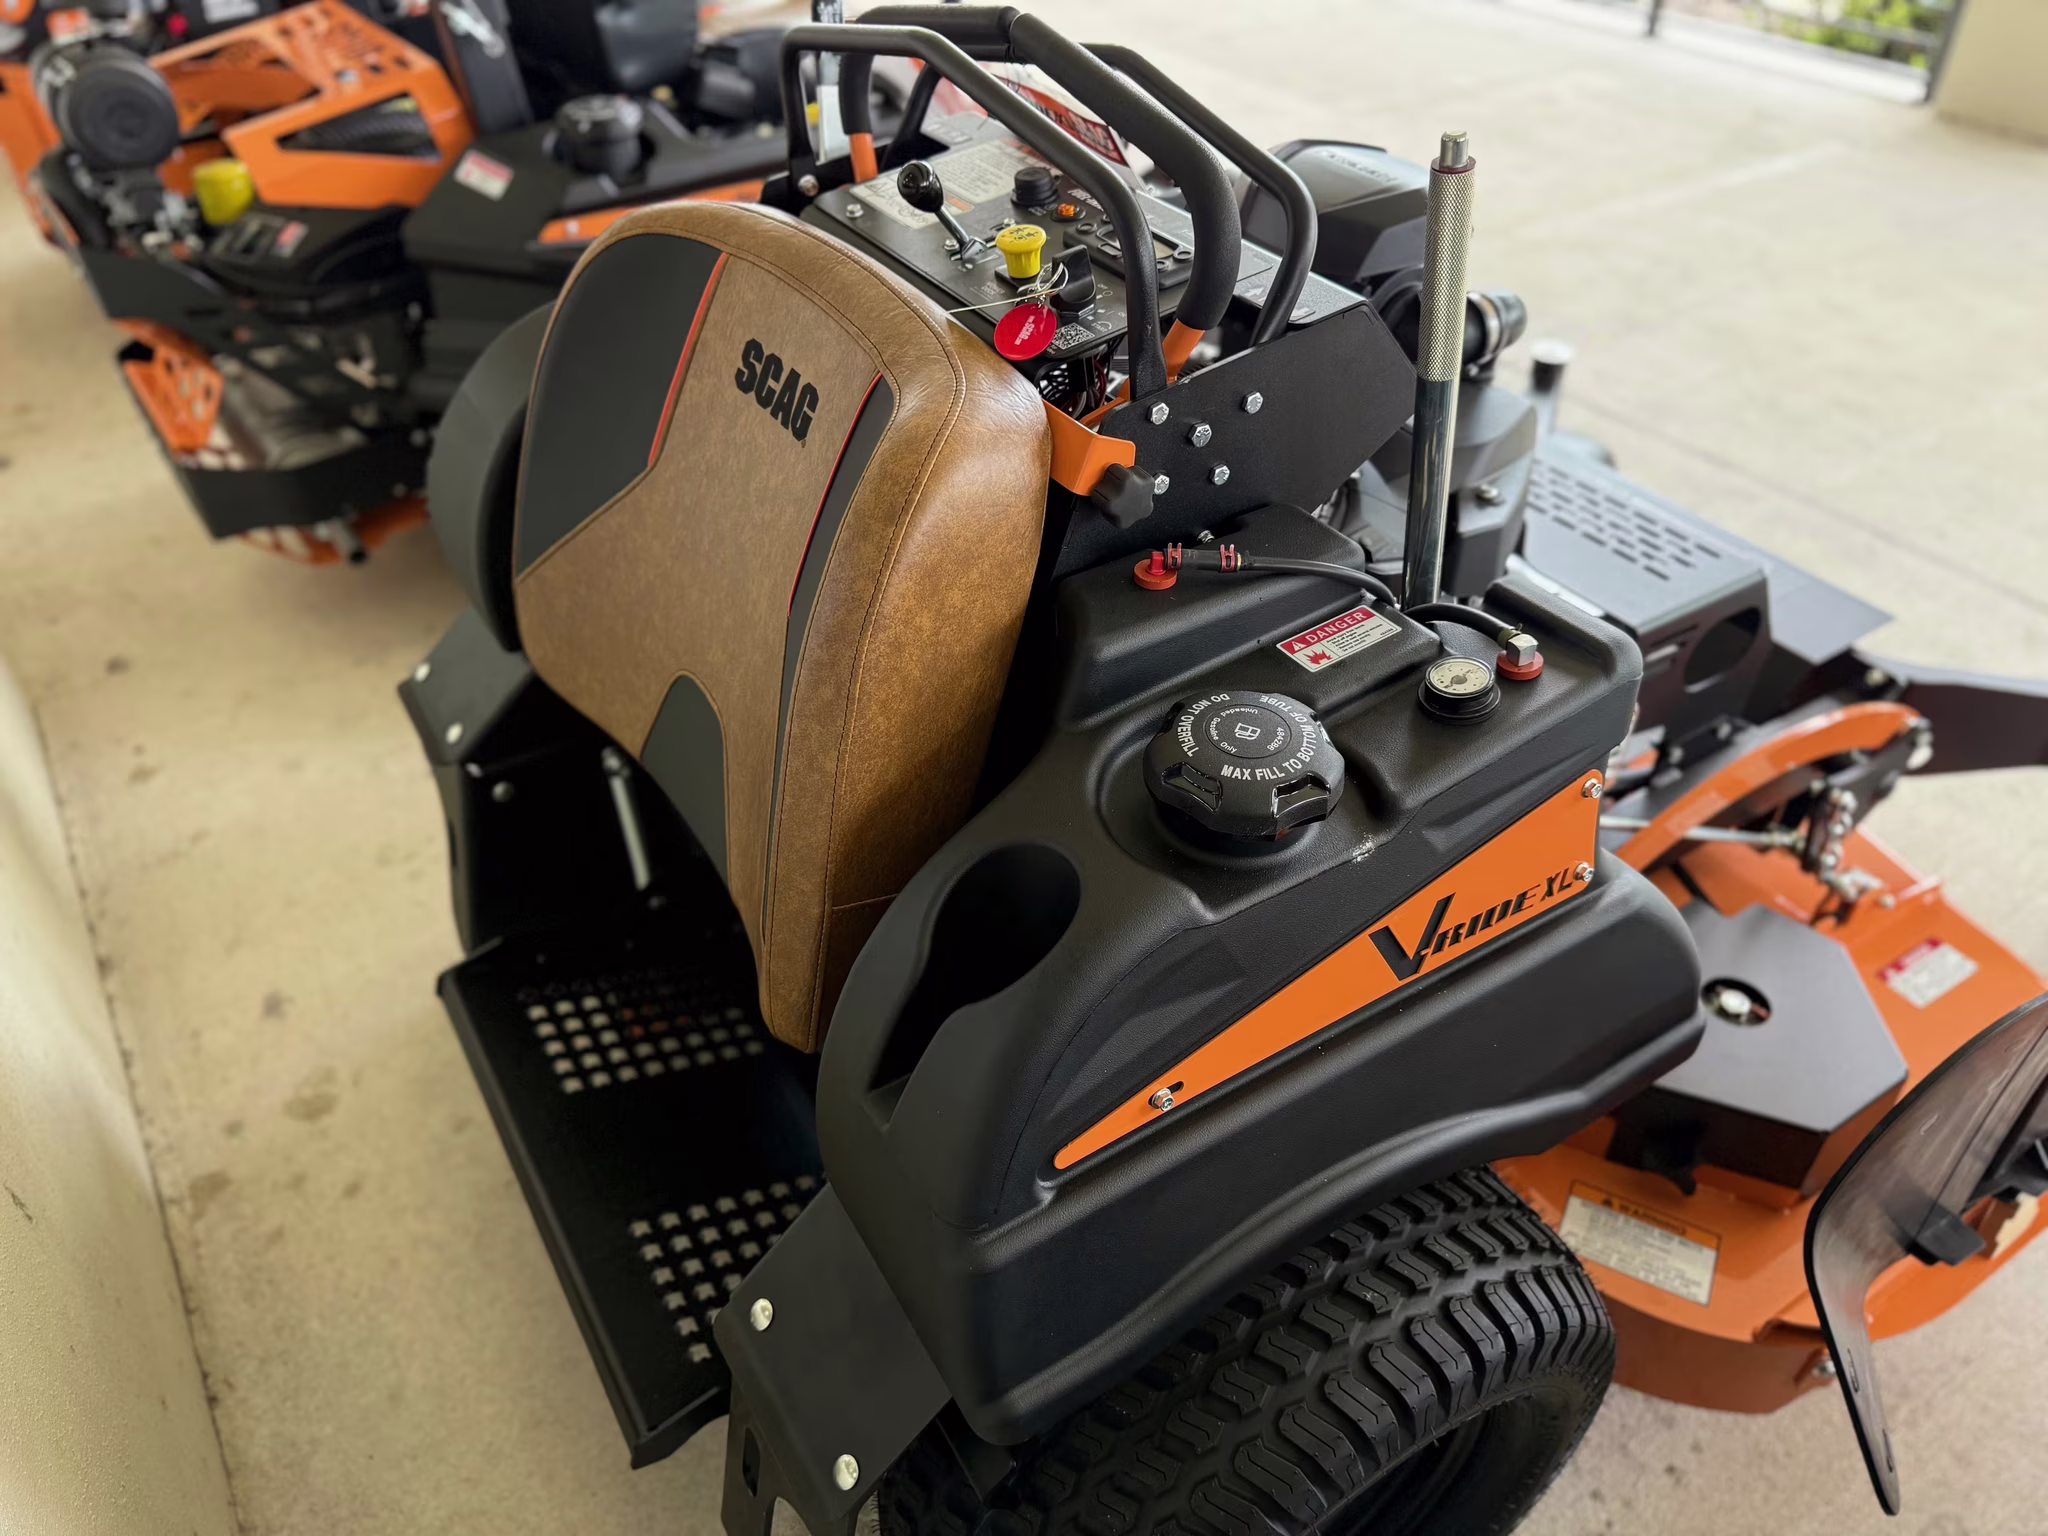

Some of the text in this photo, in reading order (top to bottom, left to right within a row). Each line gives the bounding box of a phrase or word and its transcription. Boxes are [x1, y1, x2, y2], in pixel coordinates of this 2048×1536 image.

[735, 338, 819, 441] SCAG
[1305, 612, 1366, 643] DANGER
[1177, 693, 1230, 757] DO NOT OVERFILL
[1220, 695, 1317, 781] MAX FILL TO BOTTOM OF TUBE
[1220, 741, 1237, 754] Only
[1541, 867, 1573, 902] XL
